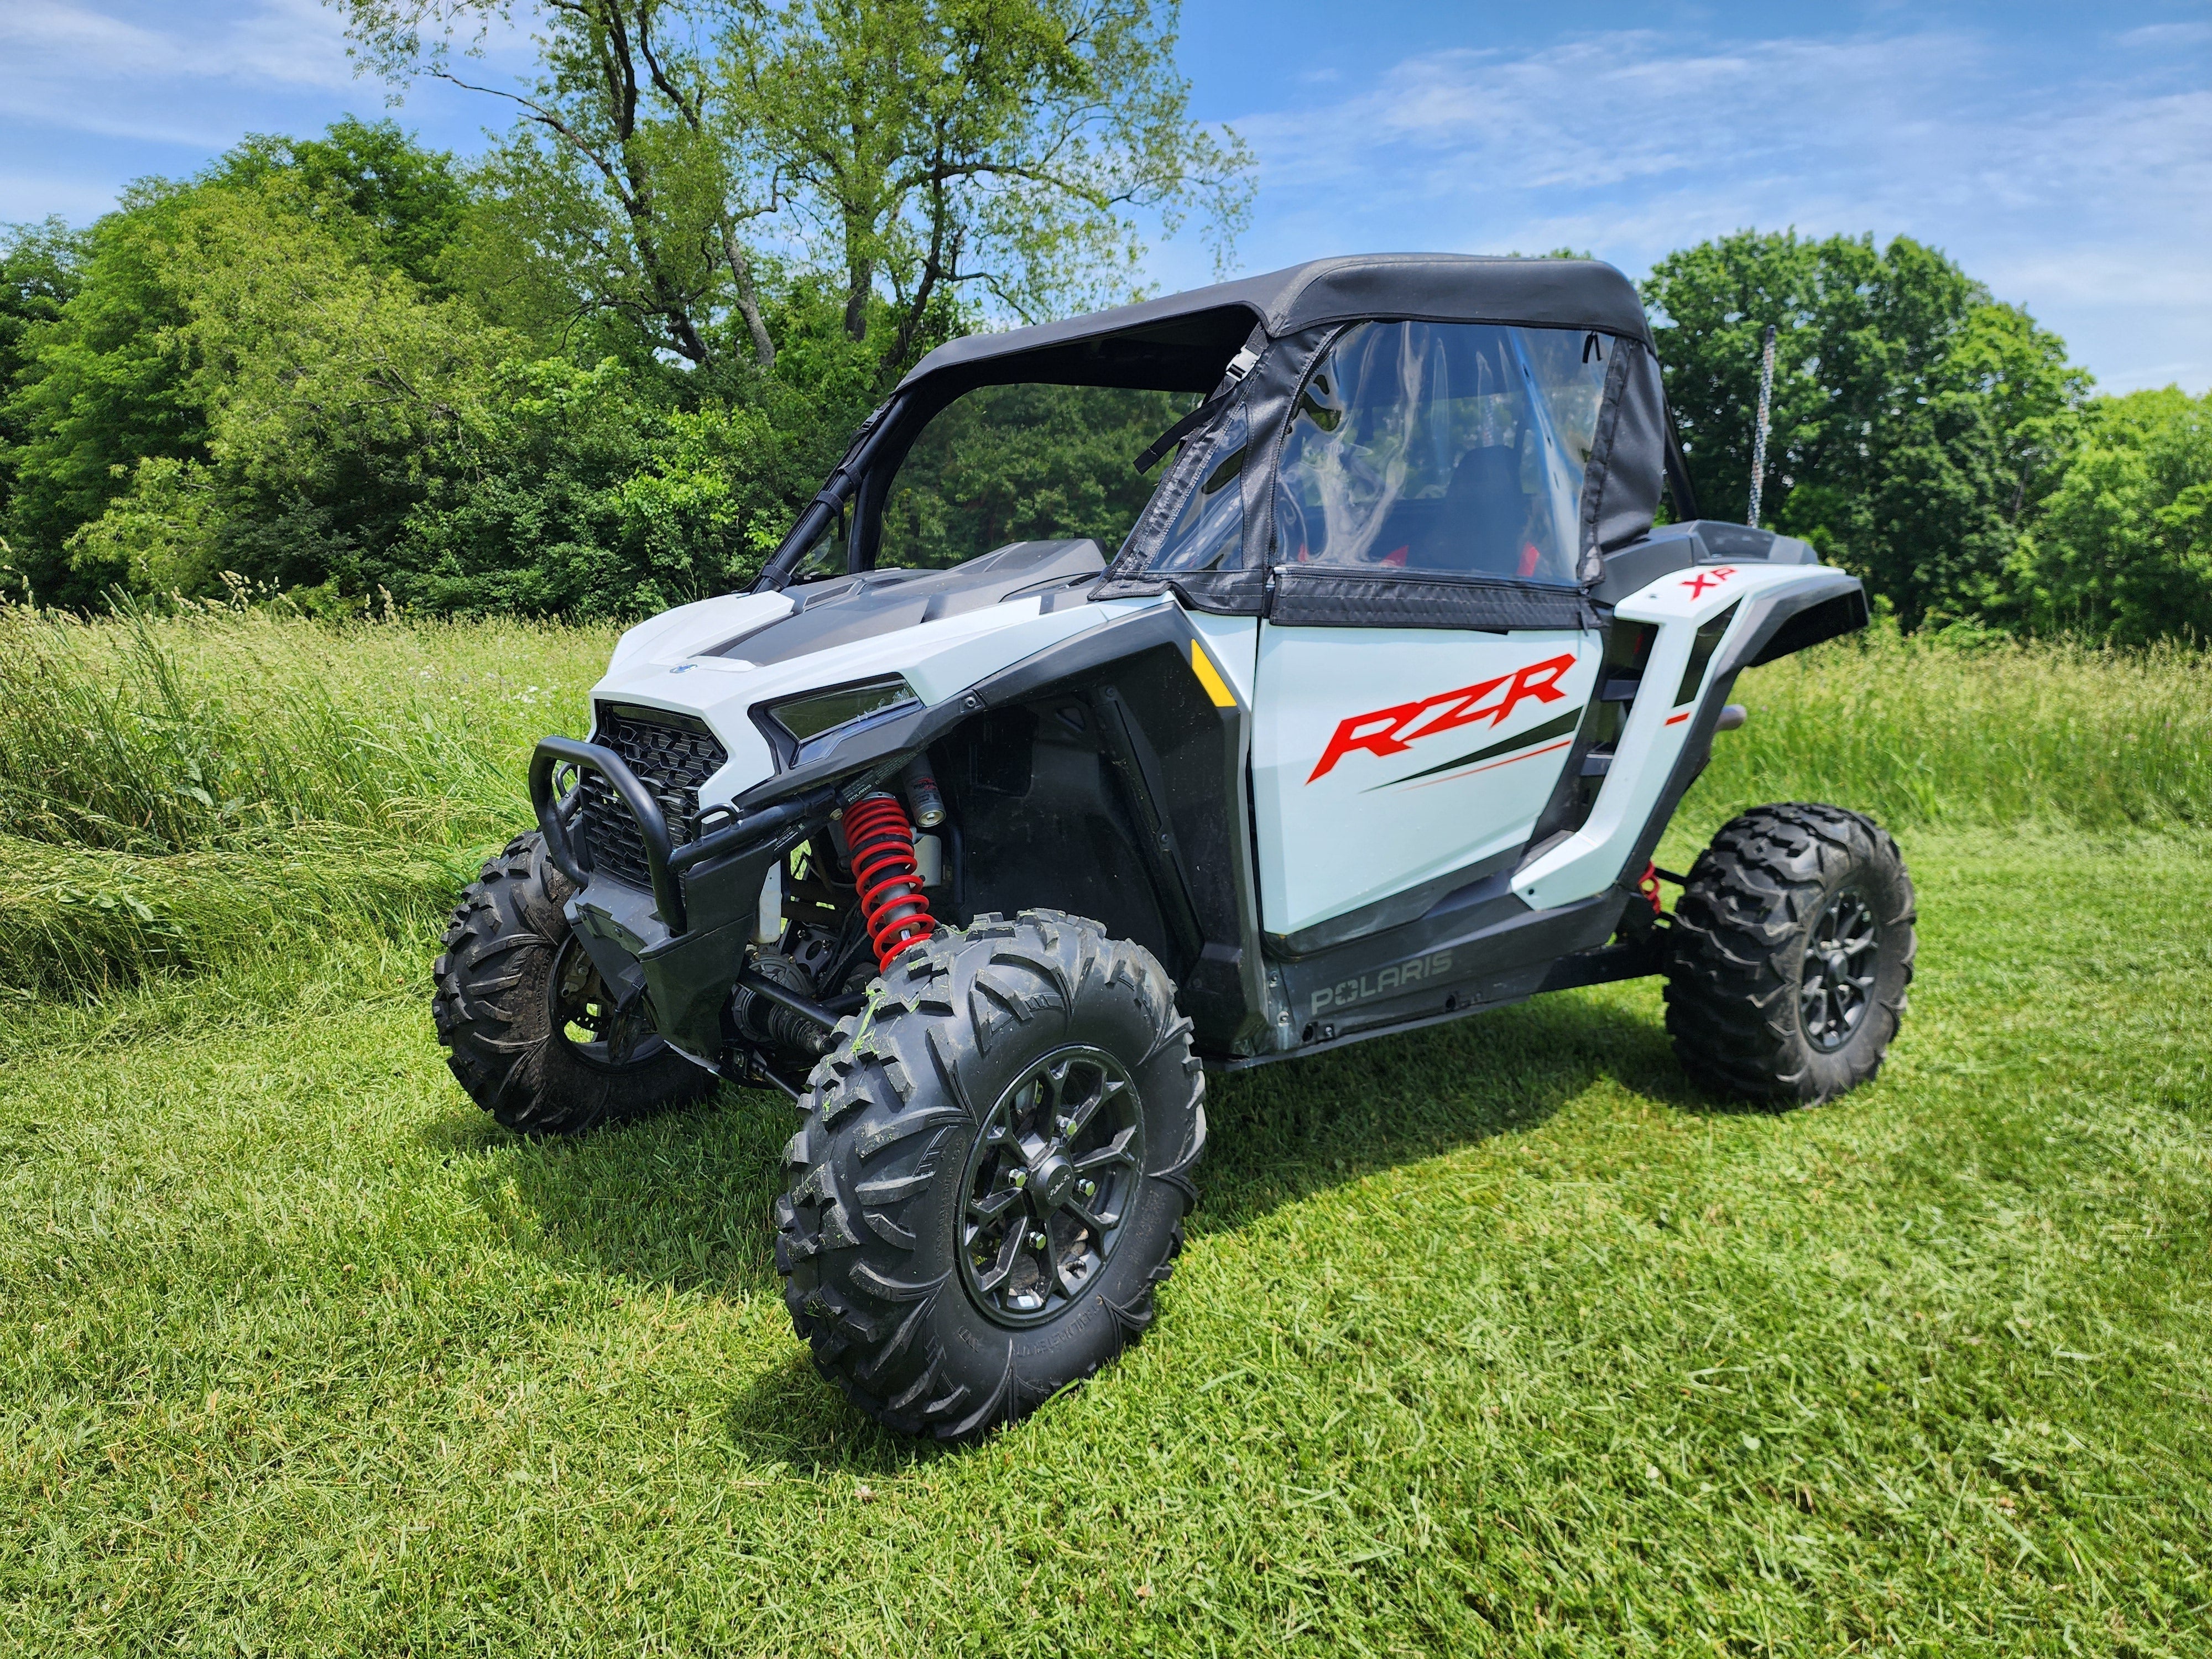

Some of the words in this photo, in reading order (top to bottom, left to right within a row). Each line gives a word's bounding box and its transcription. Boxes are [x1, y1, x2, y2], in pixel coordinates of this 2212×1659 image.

[1680, 567, 1736, 601] XP
[1305, 653, 1577, 786] RZR
[848, 784, 872, 802] POLARIS
[1311, 950, 1453, 1015] POLARIS
